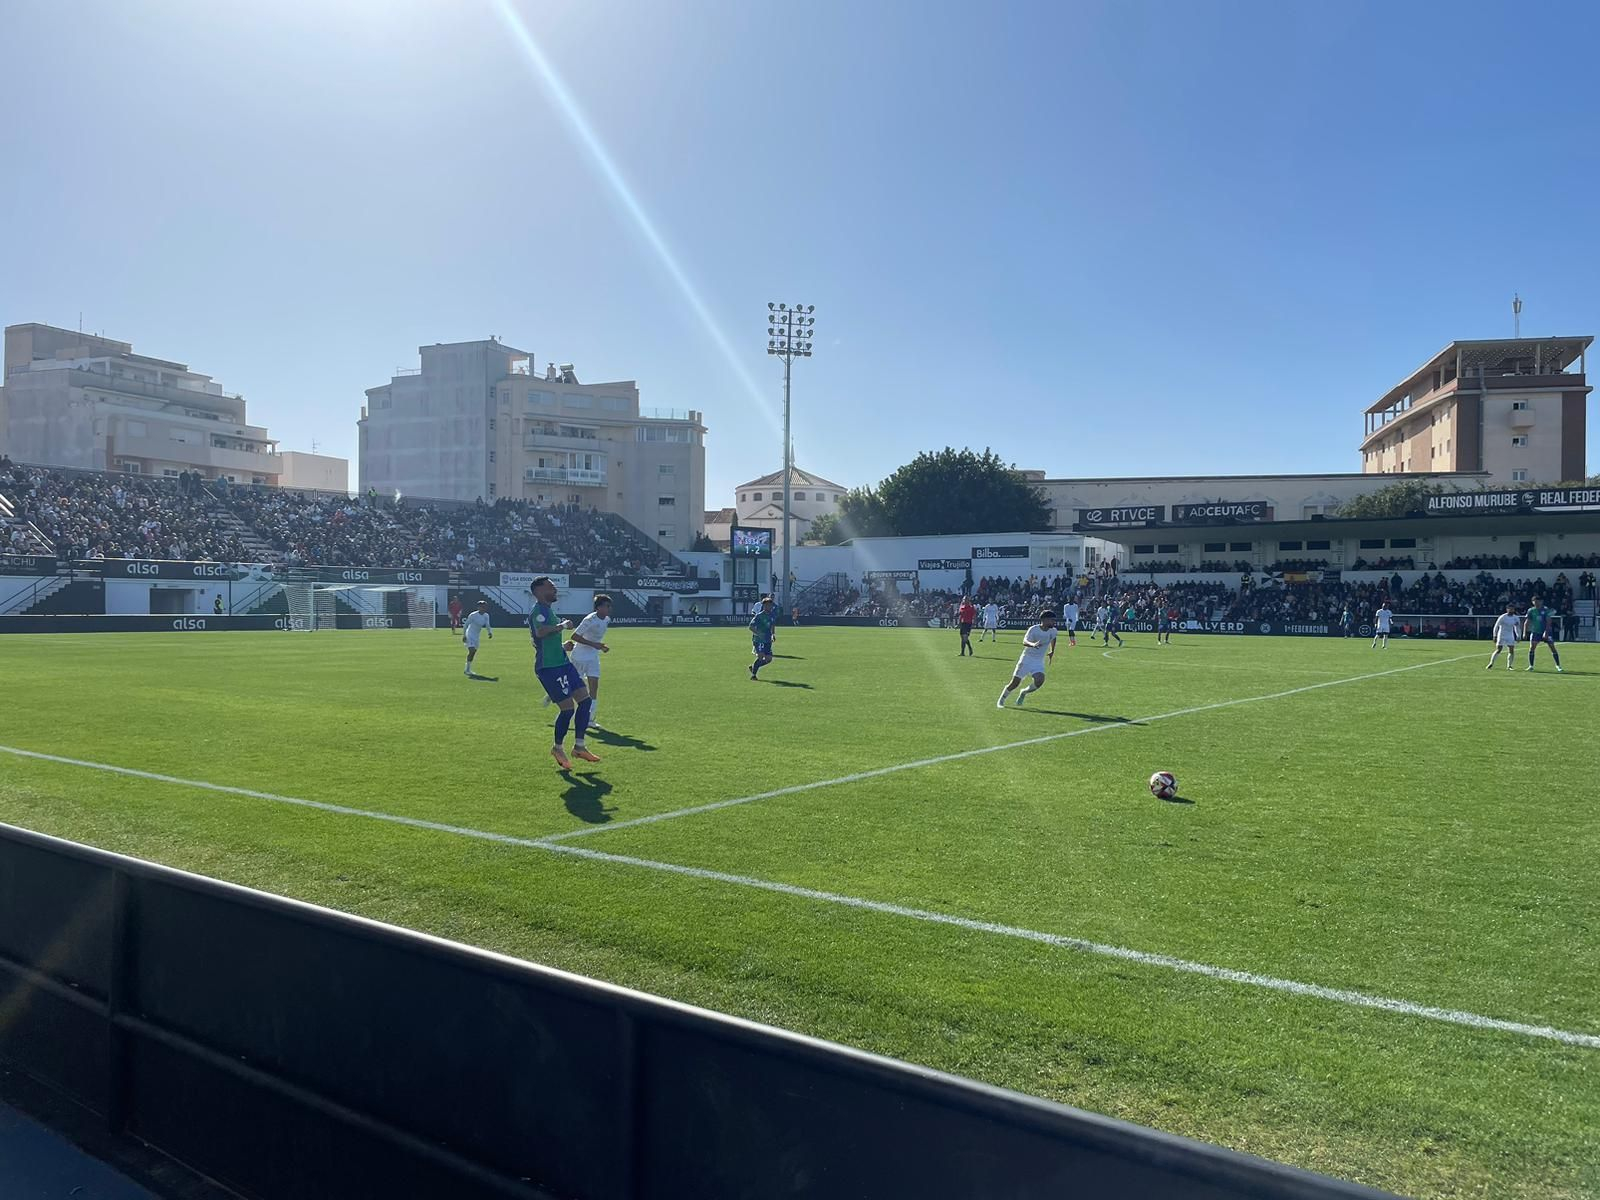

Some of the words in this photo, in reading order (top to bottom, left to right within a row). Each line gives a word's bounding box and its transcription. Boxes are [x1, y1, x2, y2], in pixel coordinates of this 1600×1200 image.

[1428, 496, 1472, 509] ALFONSO
[1475, 493, 1517, 507] MURUBE
[1540, 492, 1566, 505] REAL
[1111, 507, 1155, 522] RTVCE
[127, 563, 159, 575] alsa
[193, 564, 222, 576] alsa
[919, 561, 940, 570] Viajes
[945, 560, 970, 569] Trujillo
[342, 570, 369, 580] alsa
[397, 571, 422, 582] alsa
[173, 617, 206, 629] alsa
[274, 617, 303, 628] alsa
[366, 617, 392, 627] alsa
[879, 619, 898, 627] alsa
[1171, 621, 1244, 631] ROALVERD
[557, 675, 569, 688] 14
